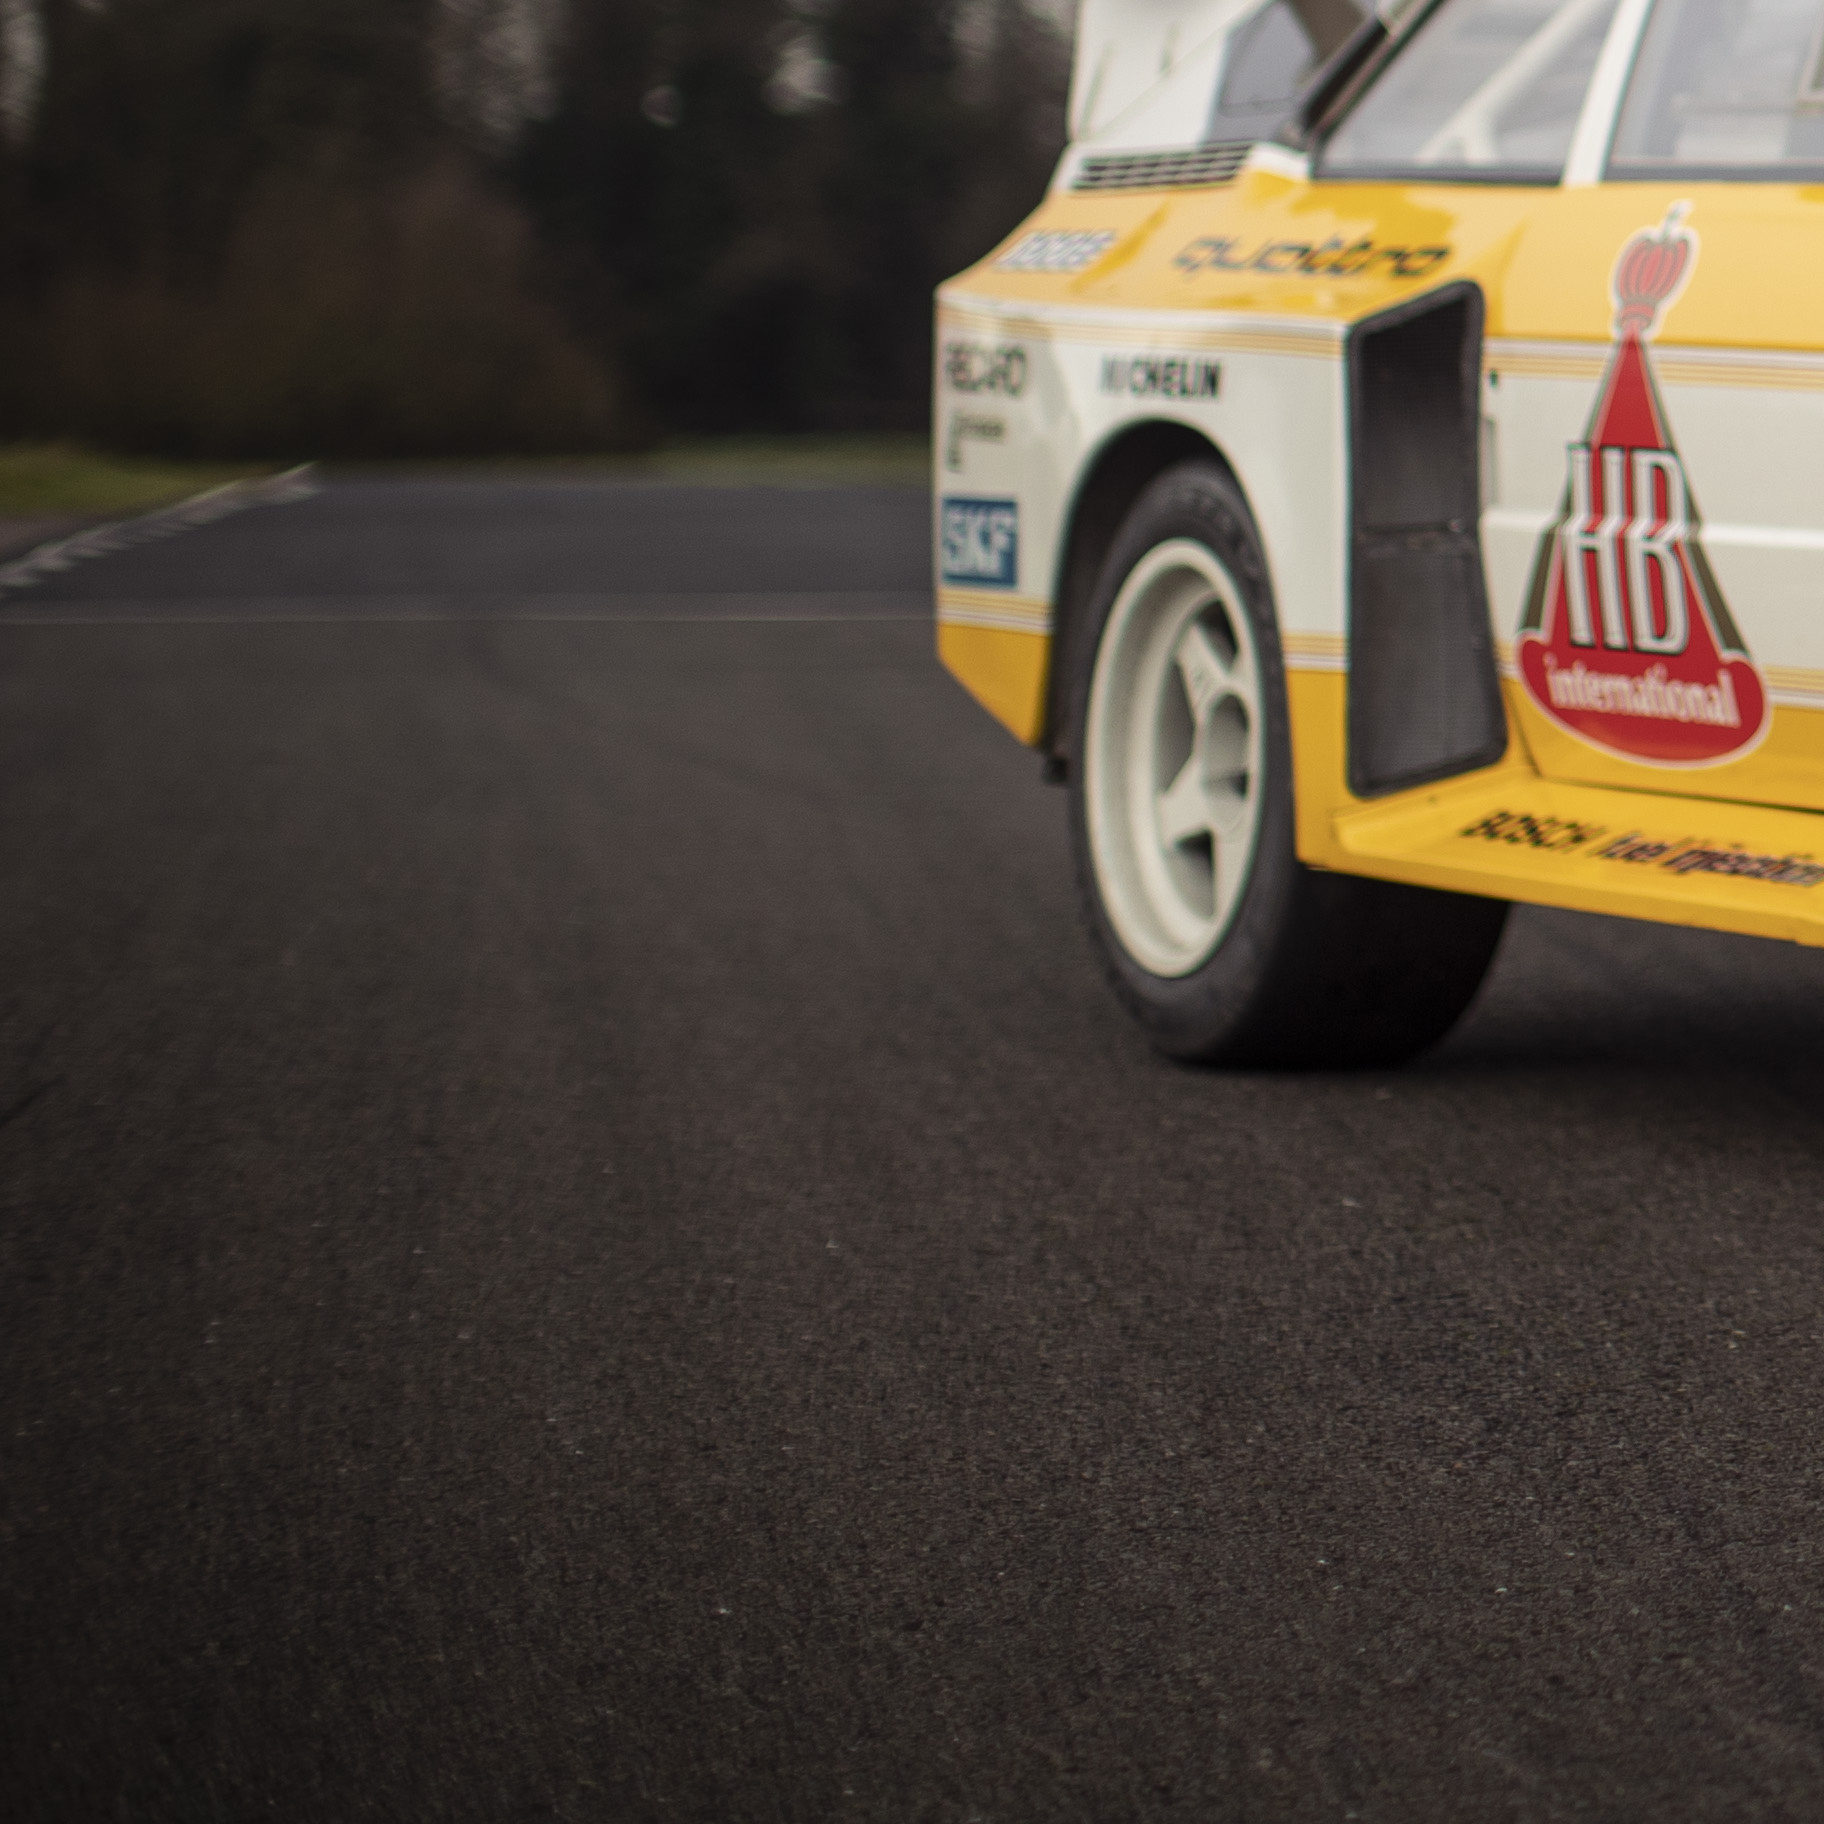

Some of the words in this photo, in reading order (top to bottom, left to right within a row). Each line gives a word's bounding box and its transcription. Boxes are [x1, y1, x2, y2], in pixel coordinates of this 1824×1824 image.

[1172, 235, 1452, 277] quattro
[1563, 441, 1692, 656] HB
[1543, 653, 1742, 729] international
